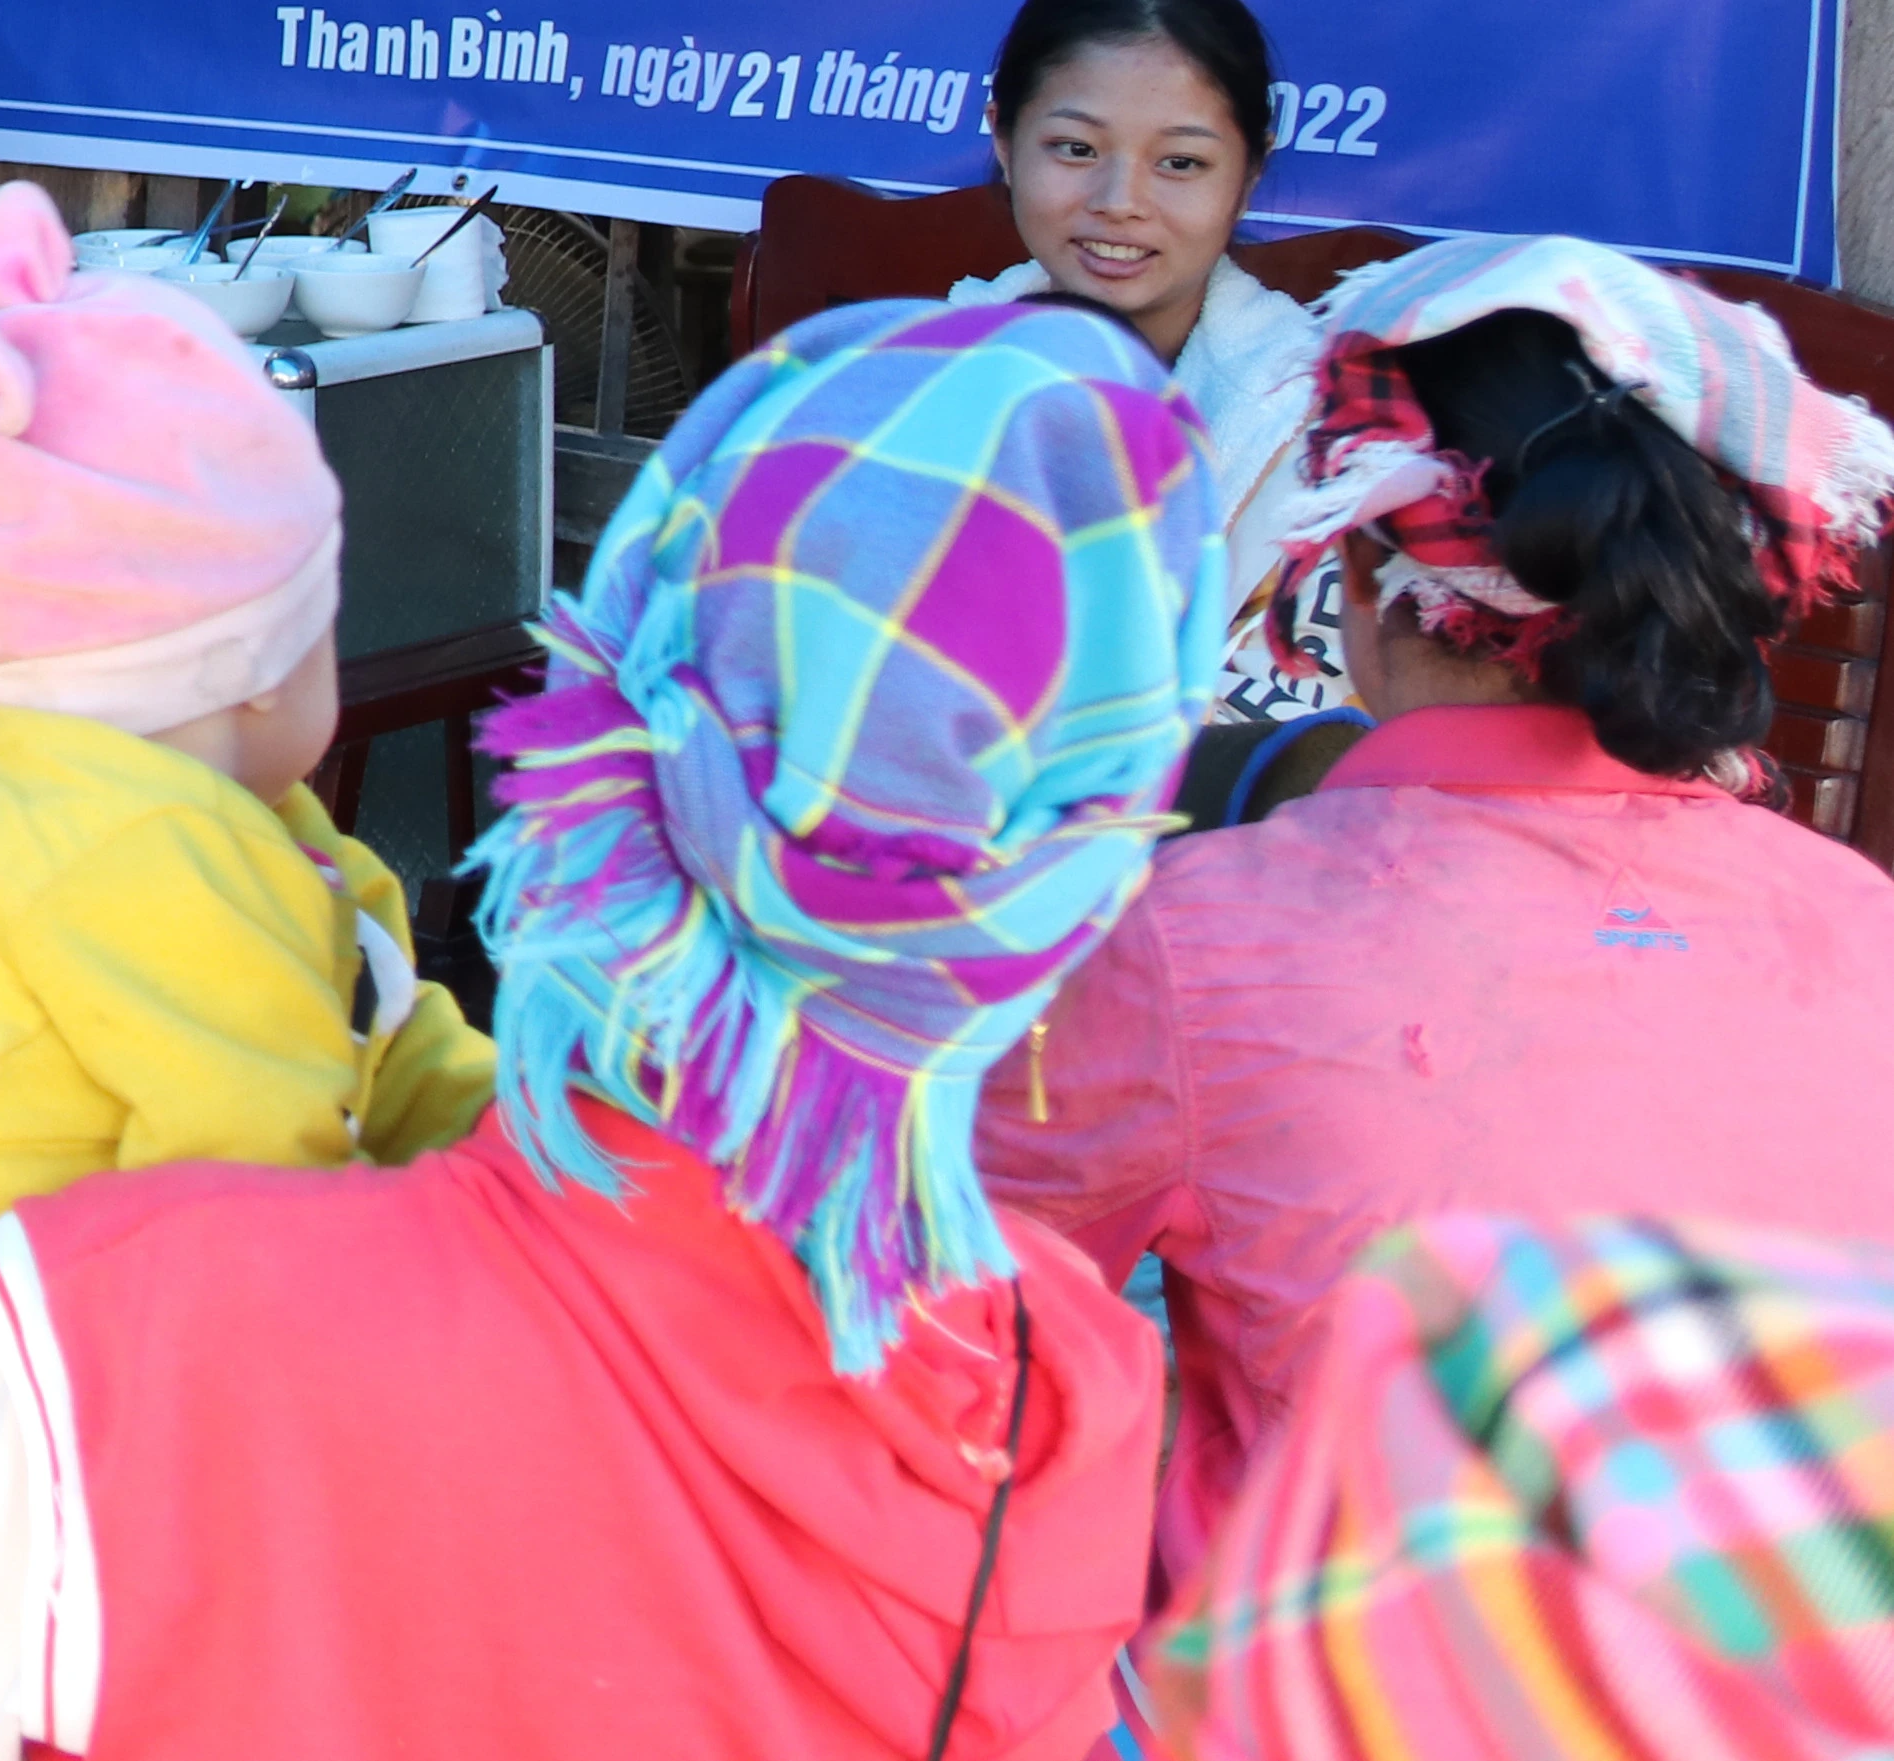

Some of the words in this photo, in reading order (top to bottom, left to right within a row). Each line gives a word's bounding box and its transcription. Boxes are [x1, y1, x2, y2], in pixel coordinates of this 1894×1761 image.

[277, 6, 439, 80] Thanh
[448, 7, 584, 101] Bình,
[601, 36, 736, 113] ngày
[730, 50, 802, 120] 21
[808, 50, 968, 135] tháng
[1267, 80, 1388, 157] 022
